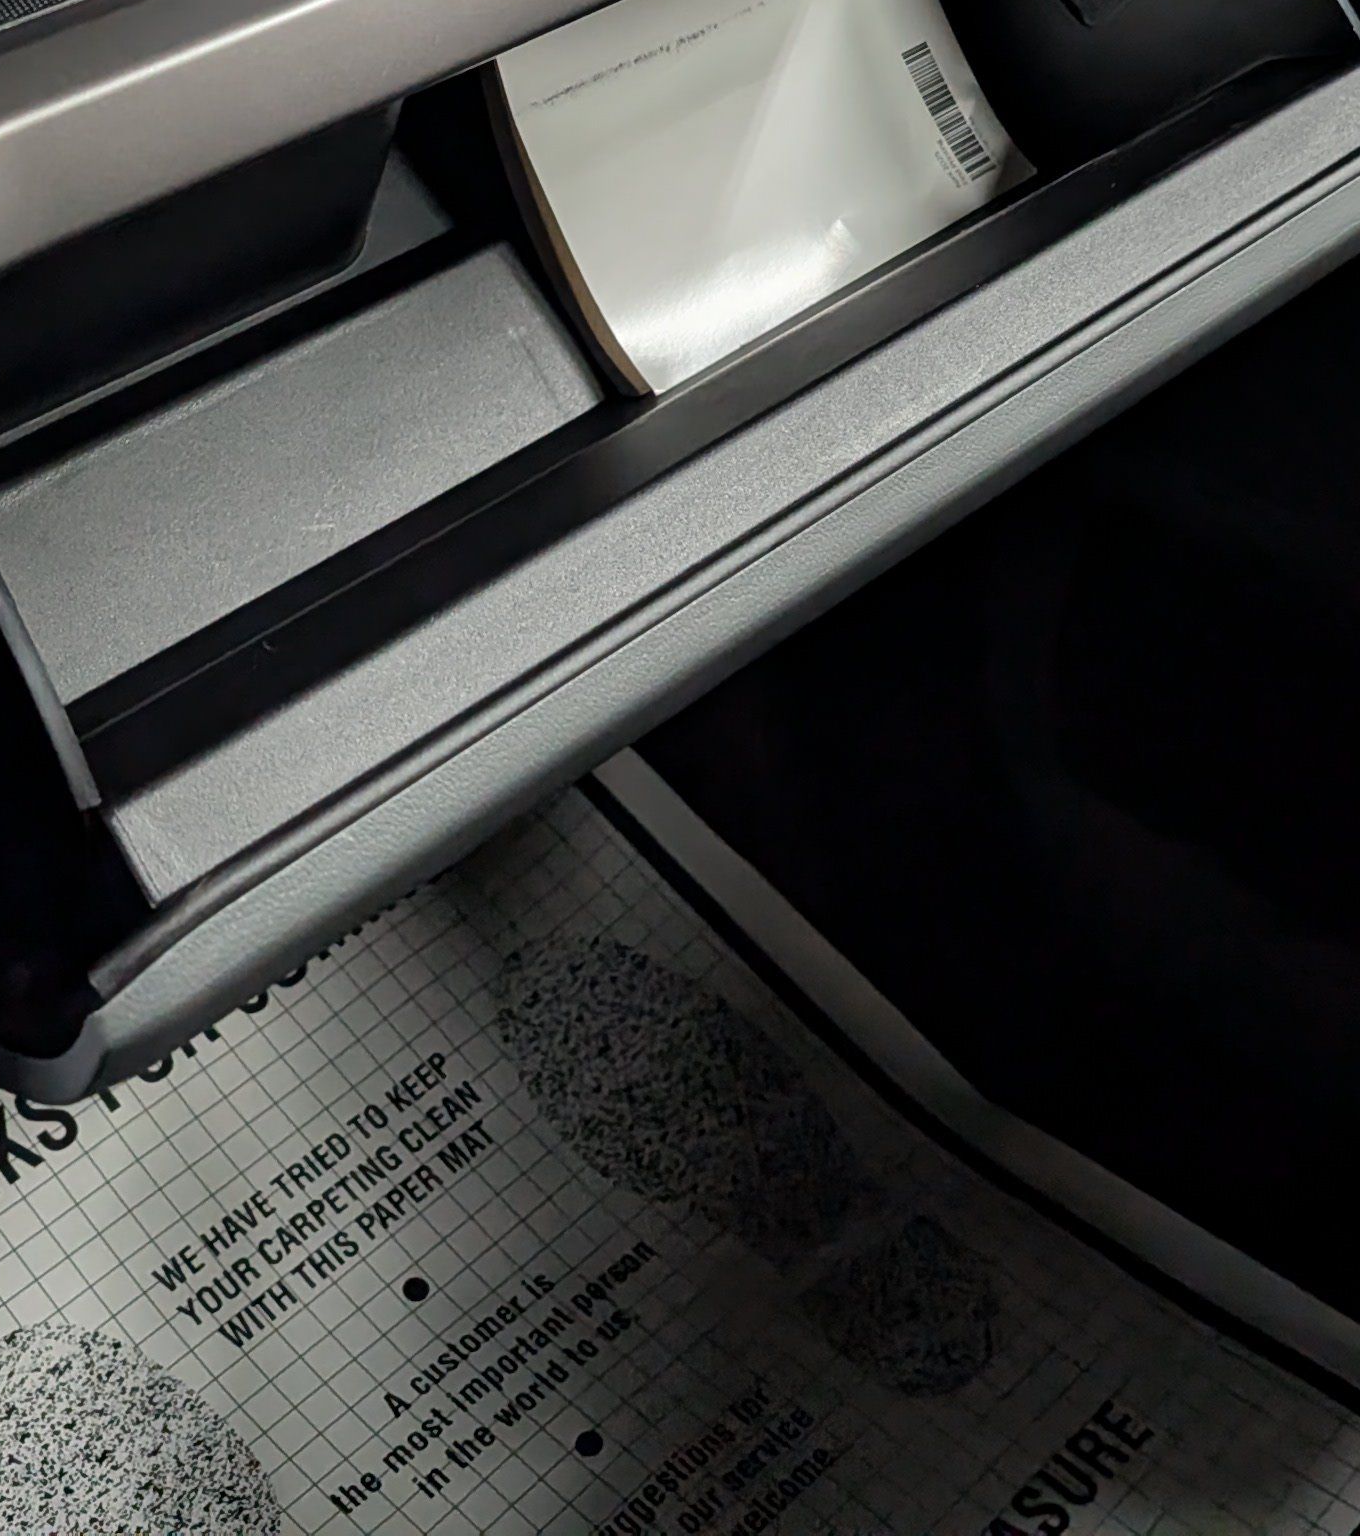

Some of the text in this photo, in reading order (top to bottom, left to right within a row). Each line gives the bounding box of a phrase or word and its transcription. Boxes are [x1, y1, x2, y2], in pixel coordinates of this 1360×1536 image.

[151, 1052, 447, 1292] WE HAVE TRIED TO KEEP
[176, 1080, 482, 1326] YOUR CARPETING CLEAN
[217, 1118, 494, 1348] WITH THIS PAPER MAT
[330, 1240, 660, 1515] the most important person
[383, 1273, 556, 1419] A customer is
[411, 1467, 451, 1499] in
[444, 1425, 496, 1469] the
[493, 1359, 571, 1428] world
[562, 1338, 600, 1366] to
[677, 1405, 815, 1535] our service
